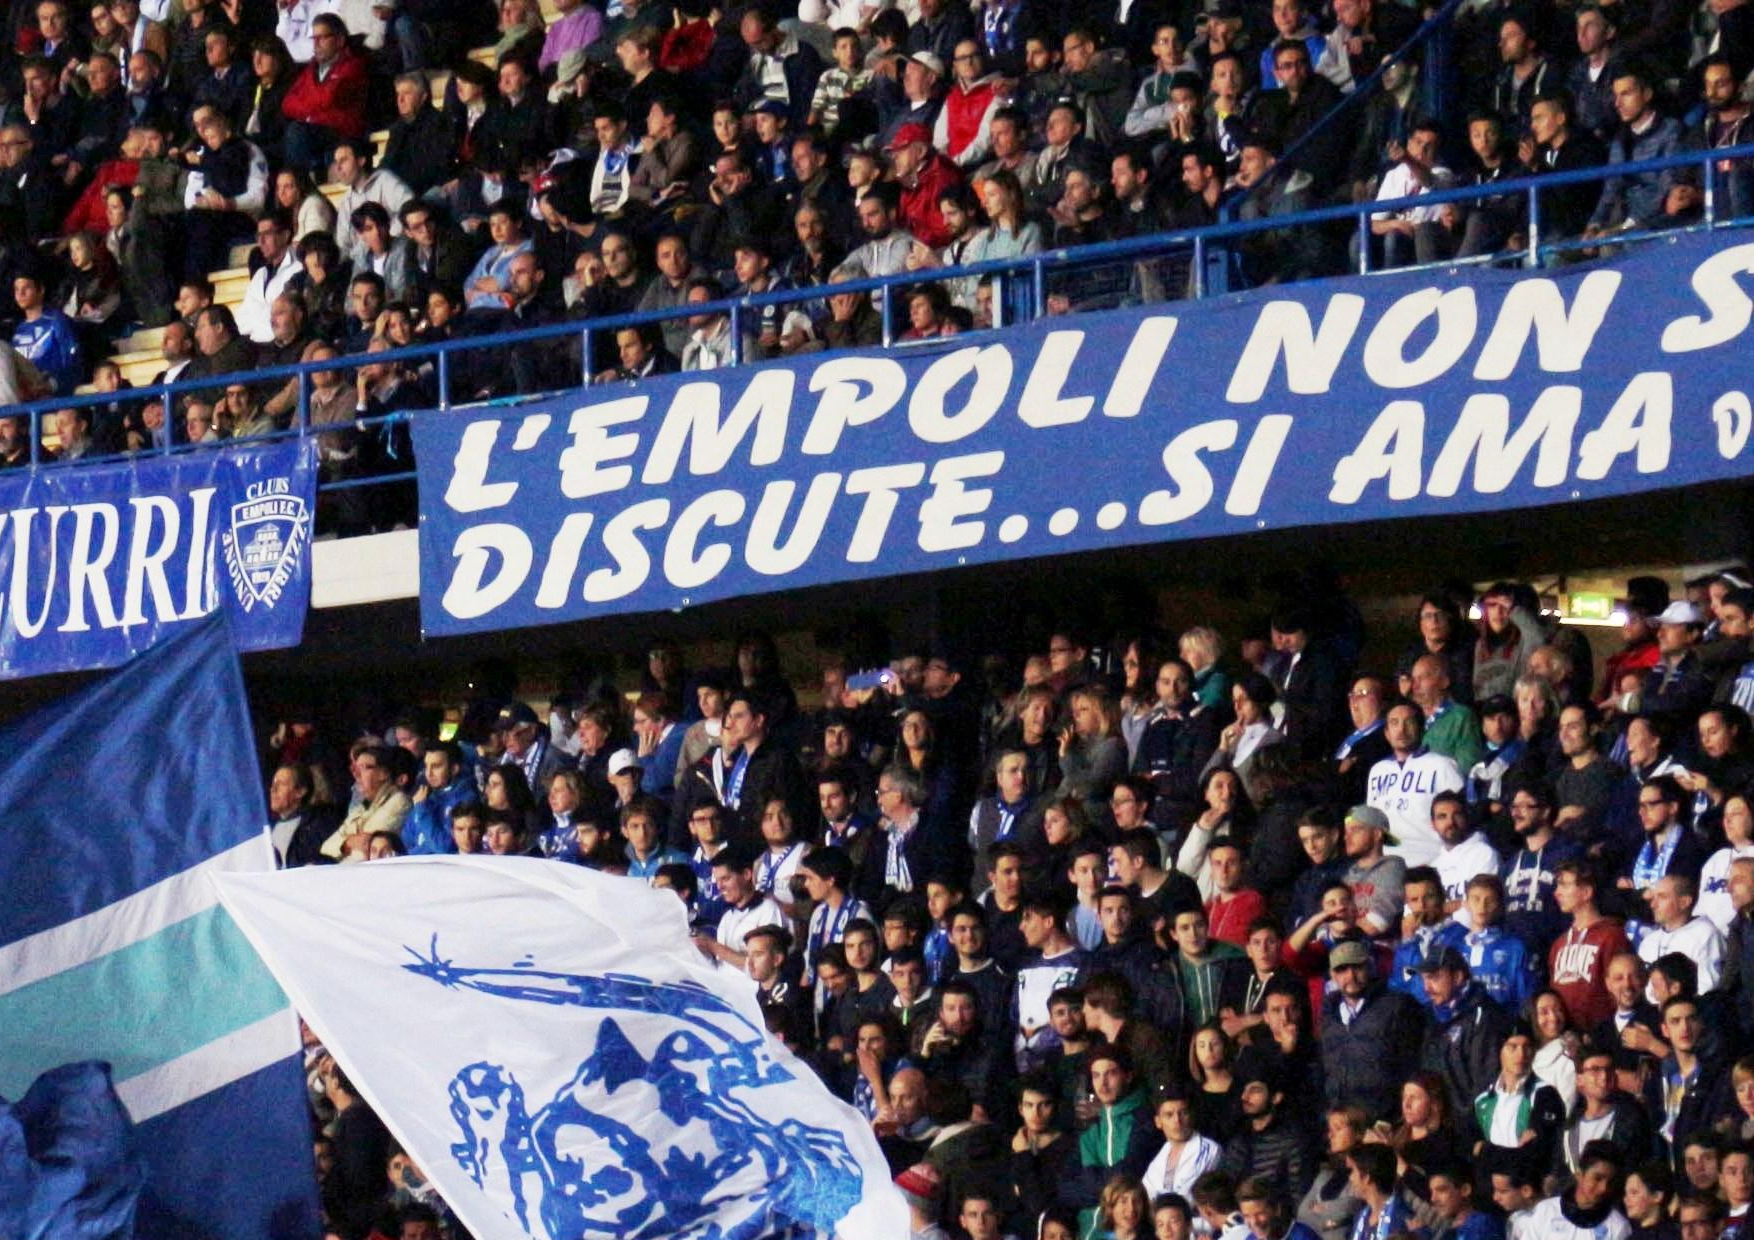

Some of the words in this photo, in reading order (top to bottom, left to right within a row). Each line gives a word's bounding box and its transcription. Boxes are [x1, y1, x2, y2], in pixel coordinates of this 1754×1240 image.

[445, 316, 1178, 513] L'EMPOLI
[1226, 269, 1622, 404] NON
[1329, 372, 1673, 504] AMA
